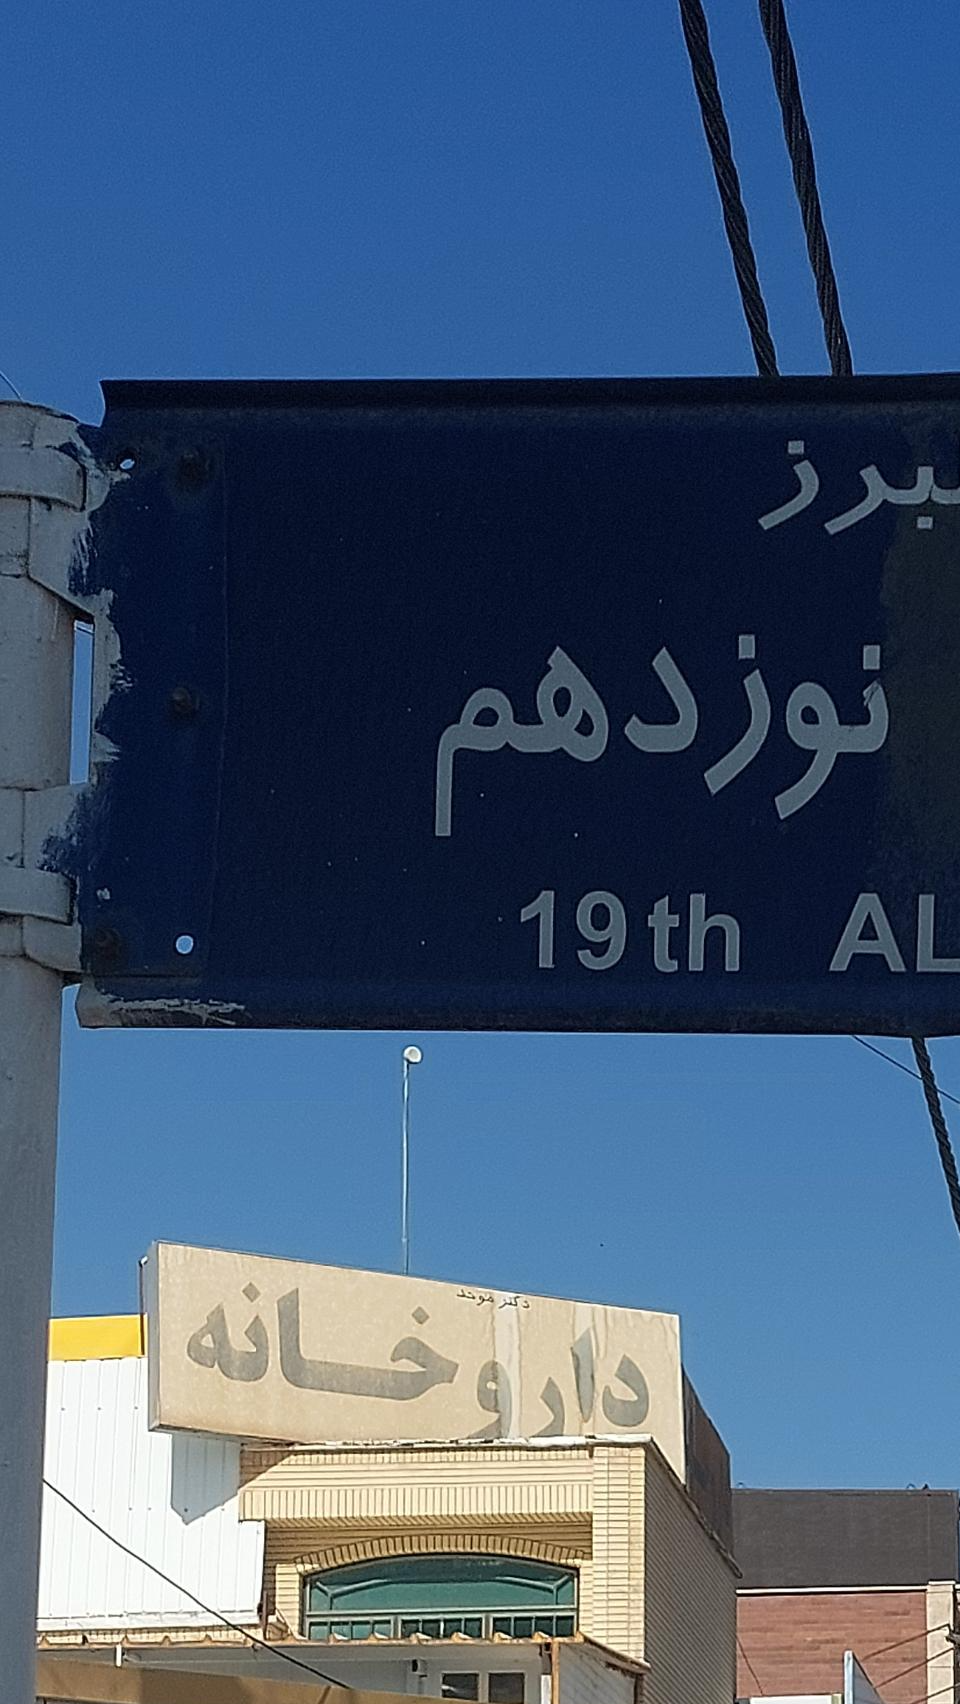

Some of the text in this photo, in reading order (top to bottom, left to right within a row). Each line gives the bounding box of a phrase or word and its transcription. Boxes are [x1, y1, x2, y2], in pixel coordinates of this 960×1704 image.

[435, 634, 889, 837] نوزدهم
[520, 890, 740, 973] 19th
[186, 1281, 650, 1440] داروخانه
